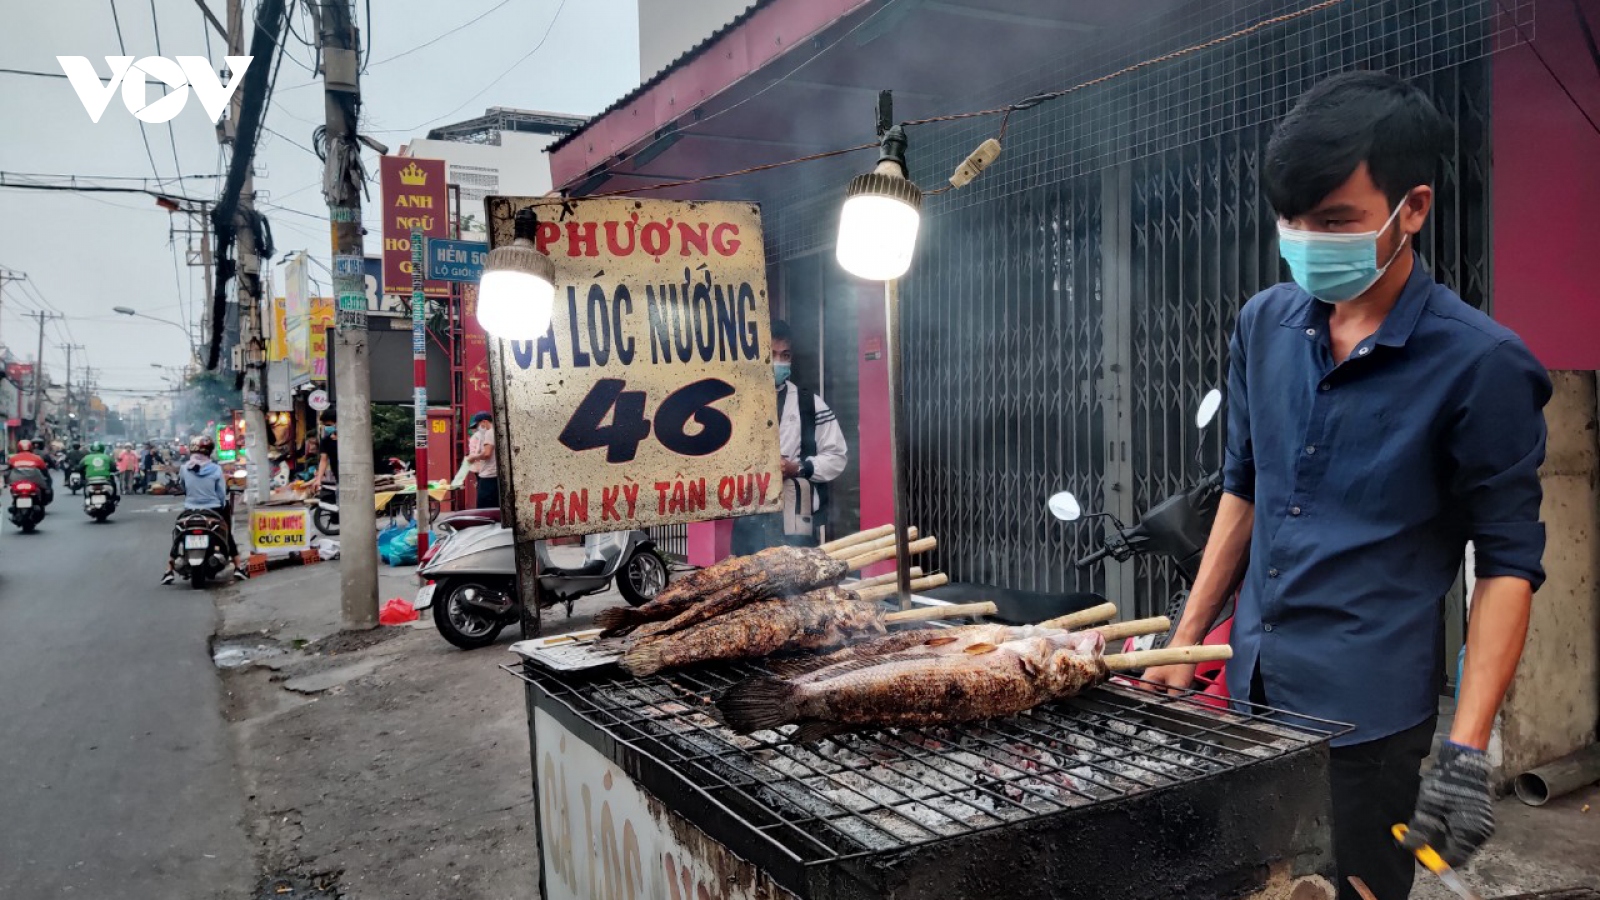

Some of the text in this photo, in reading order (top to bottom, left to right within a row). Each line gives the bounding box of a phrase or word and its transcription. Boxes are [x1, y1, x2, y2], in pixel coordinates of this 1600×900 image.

[395, 195, 433, 208] ANH
[437, 245, 467, 263] HẺM
[536, 212, 741, 263] PHƯỢNG
[435, 265, 448, 276] LỘ
[567, 269, 635, 368] LÓC
[646, 263, 760, 364] NƯỚNG
[432, 420, 445, 433] 50
[558, 378, 736, 463] 46
[530, 484, 589, 529] TÂN
[603, 476, 639, 521] KỲ
[654, 472, 706, 515] TÂN
